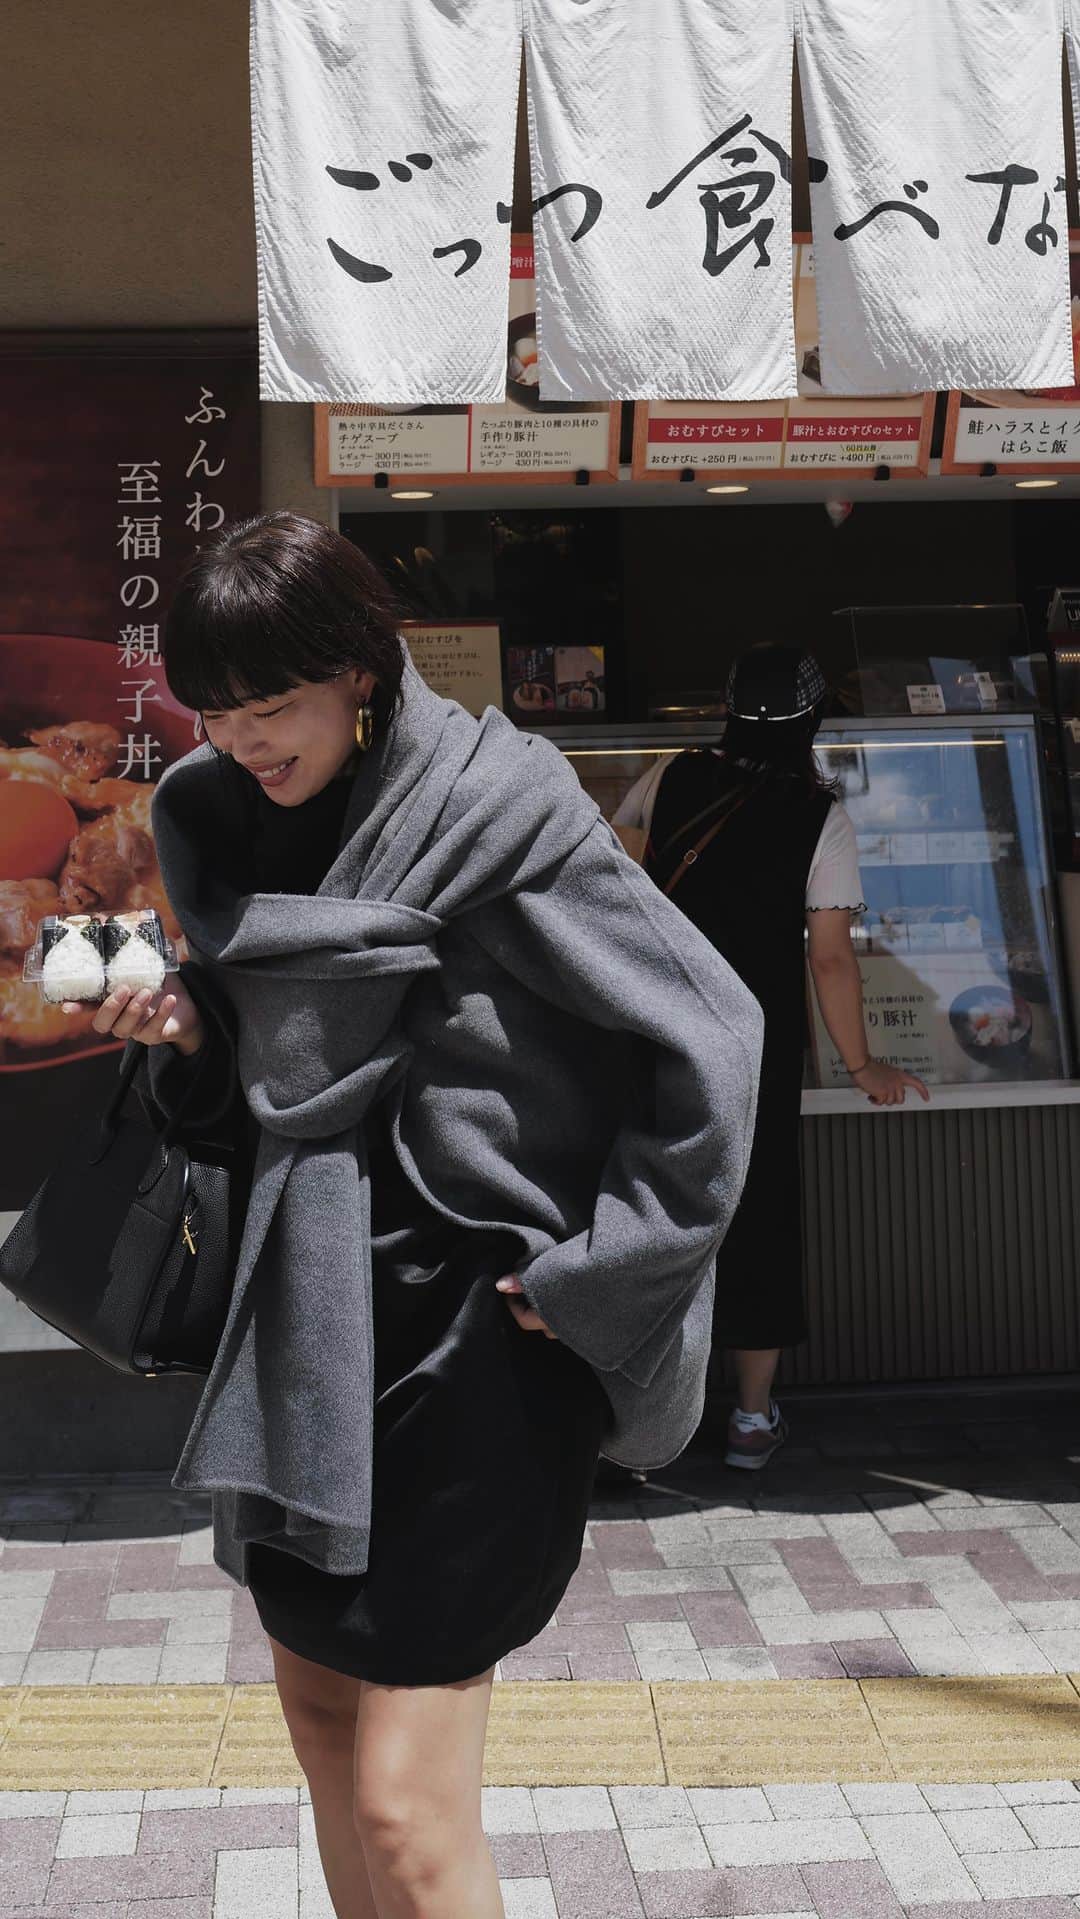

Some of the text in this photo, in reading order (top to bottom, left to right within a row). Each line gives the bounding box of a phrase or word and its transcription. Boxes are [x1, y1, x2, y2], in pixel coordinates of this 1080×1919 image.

[667, 424, 765, 437] おむすびセット
[792, 424, 915, 437] 豚汁とおむすびのセット
[338, 433, 400, 444] チゲスープ
[480, 431, 539, 443] 手作り豚汁
[1001, 439, 1068, 454] はらこ飯
[480, 450, 515, 459] レギュラー
[651, 454, 699, 464] おむすびに
[701, 454, 737, 464] +250円
[790, 453, 837, 463] おむすびに
[338, 461, 362, 469] ラージ
[480, 459, 503, 467] ラージ
[184, 387, 226, 553] ふんわ
[117, 460, 163, 780] 至福の親子丼
